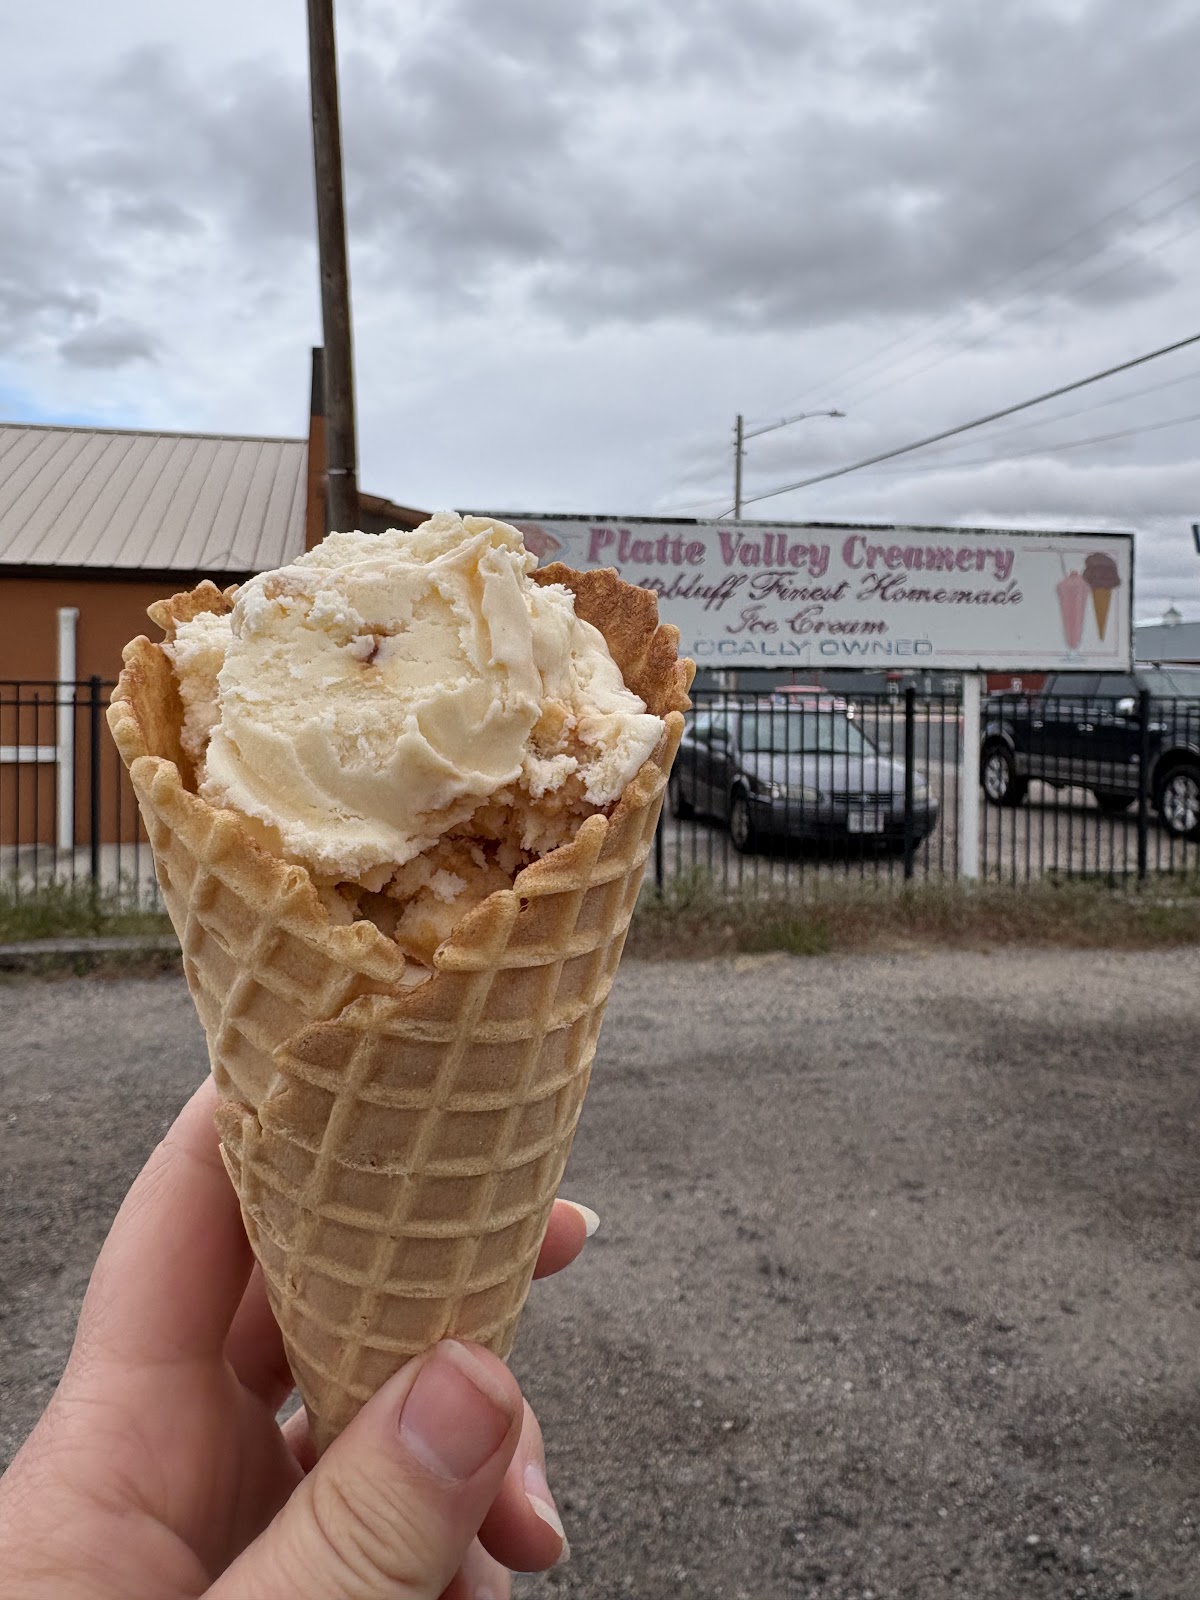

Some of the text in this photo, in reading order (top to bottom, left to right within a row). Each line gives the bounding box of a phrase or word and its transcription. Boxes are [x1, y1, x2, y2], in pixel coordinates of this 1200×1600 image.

[586, 527, 1015, 581] Platte Valley Creamery
[749, 570, 850, 601] Finest
[856, 572, 1023, 605] Homemade
[726, 603, 888, 635] Ice Cream
[819, 639, 933, 656] OWNED
